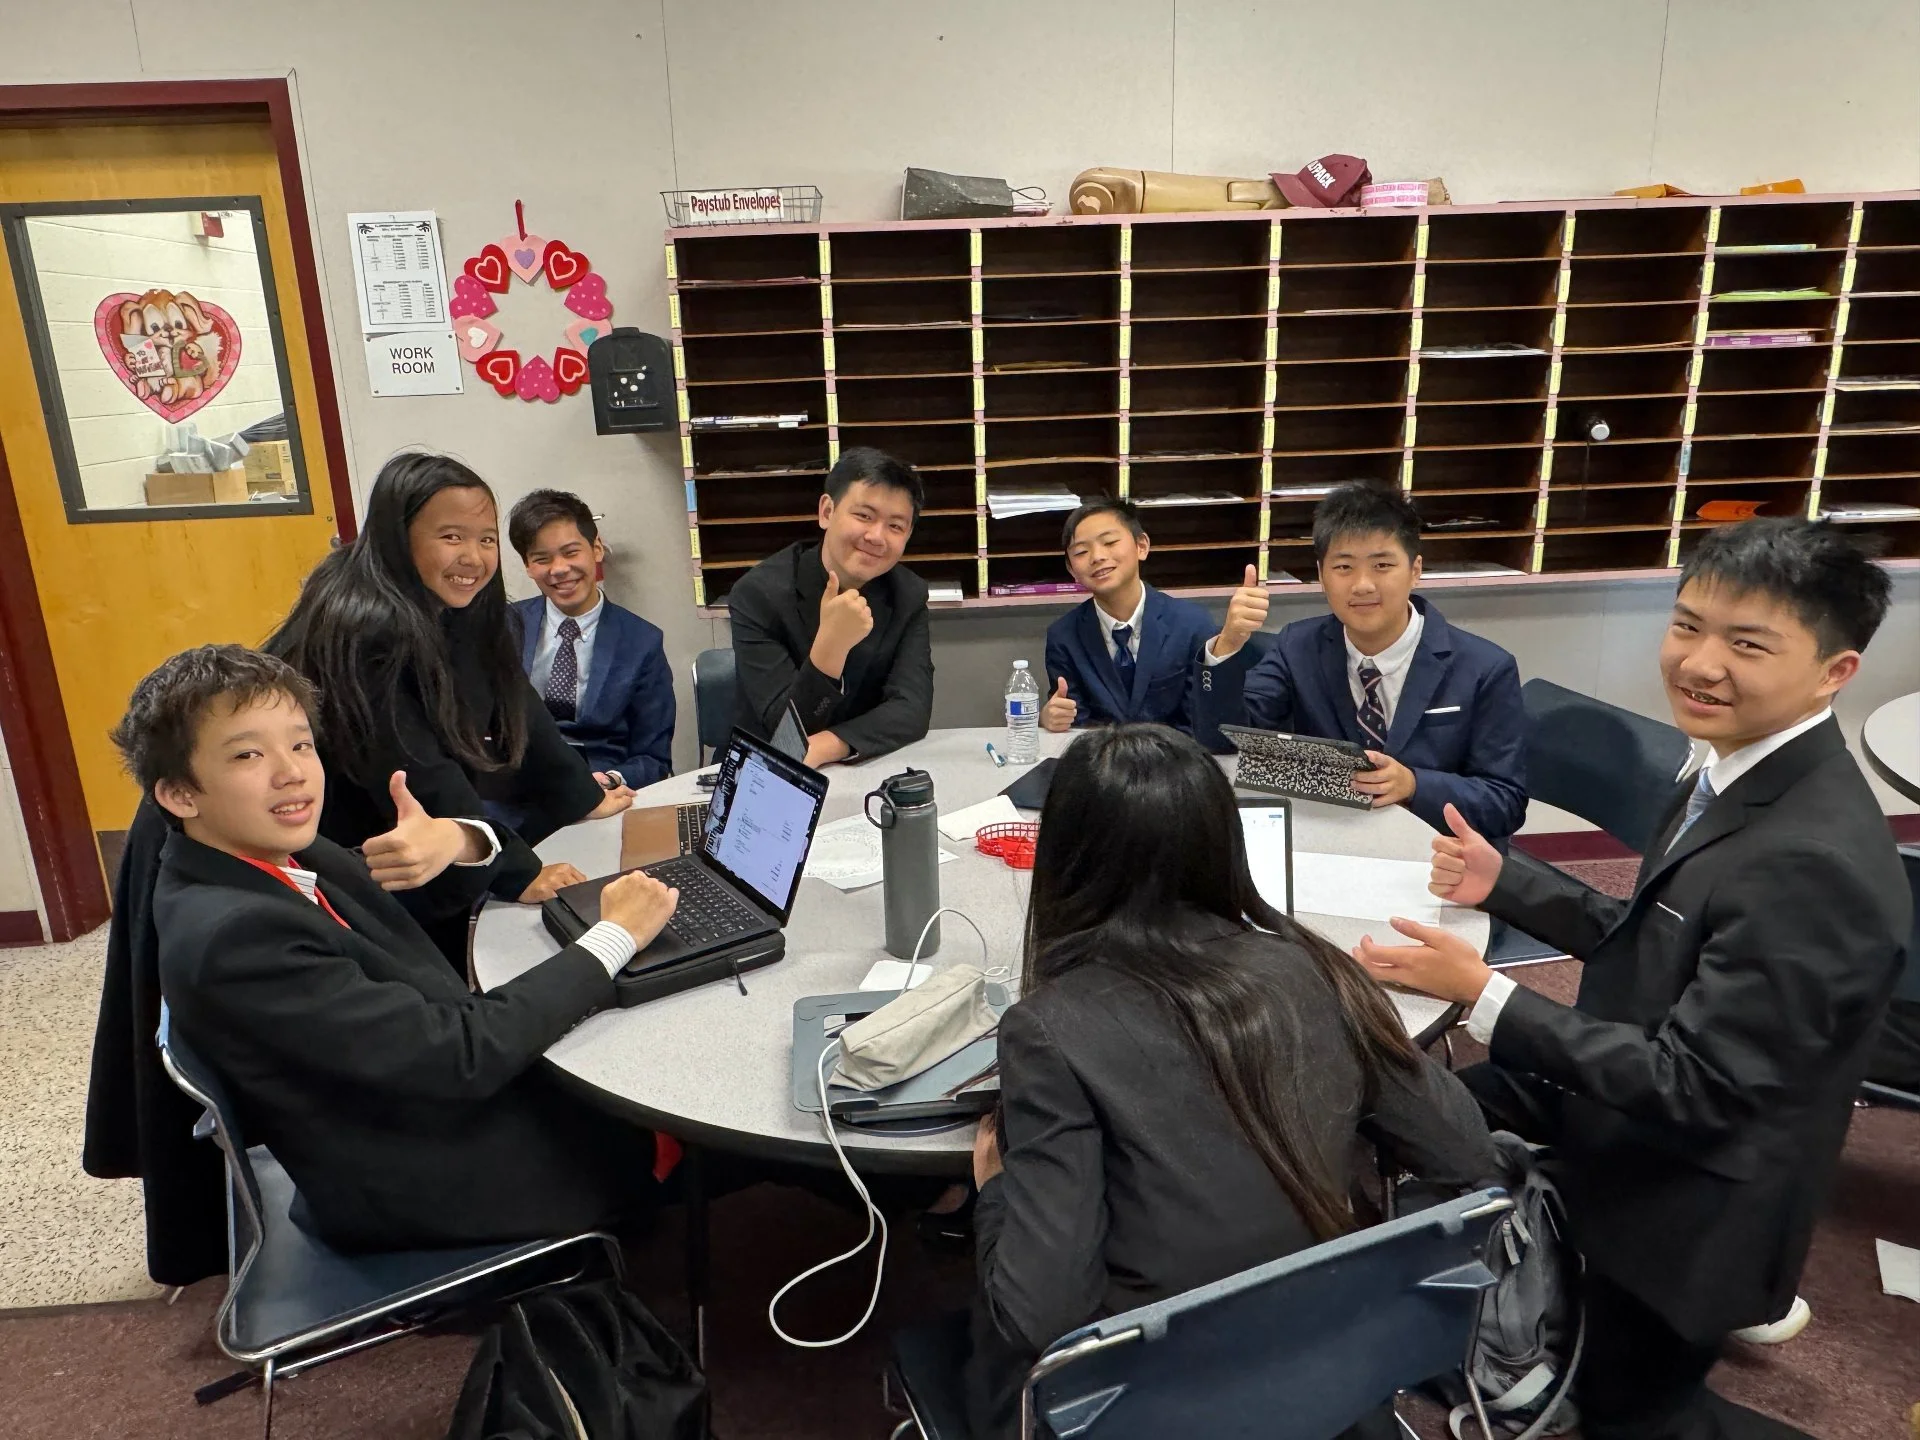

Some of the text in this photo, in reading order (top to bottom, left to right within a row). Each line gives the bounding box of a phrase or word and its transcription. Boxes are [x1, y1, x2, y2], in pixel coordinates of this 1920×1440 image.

[690, 191, 782, 216] Paystub Envelopes
[389, 347, 434, 359] WORK
[391, 361, 435, 374] ROOM
